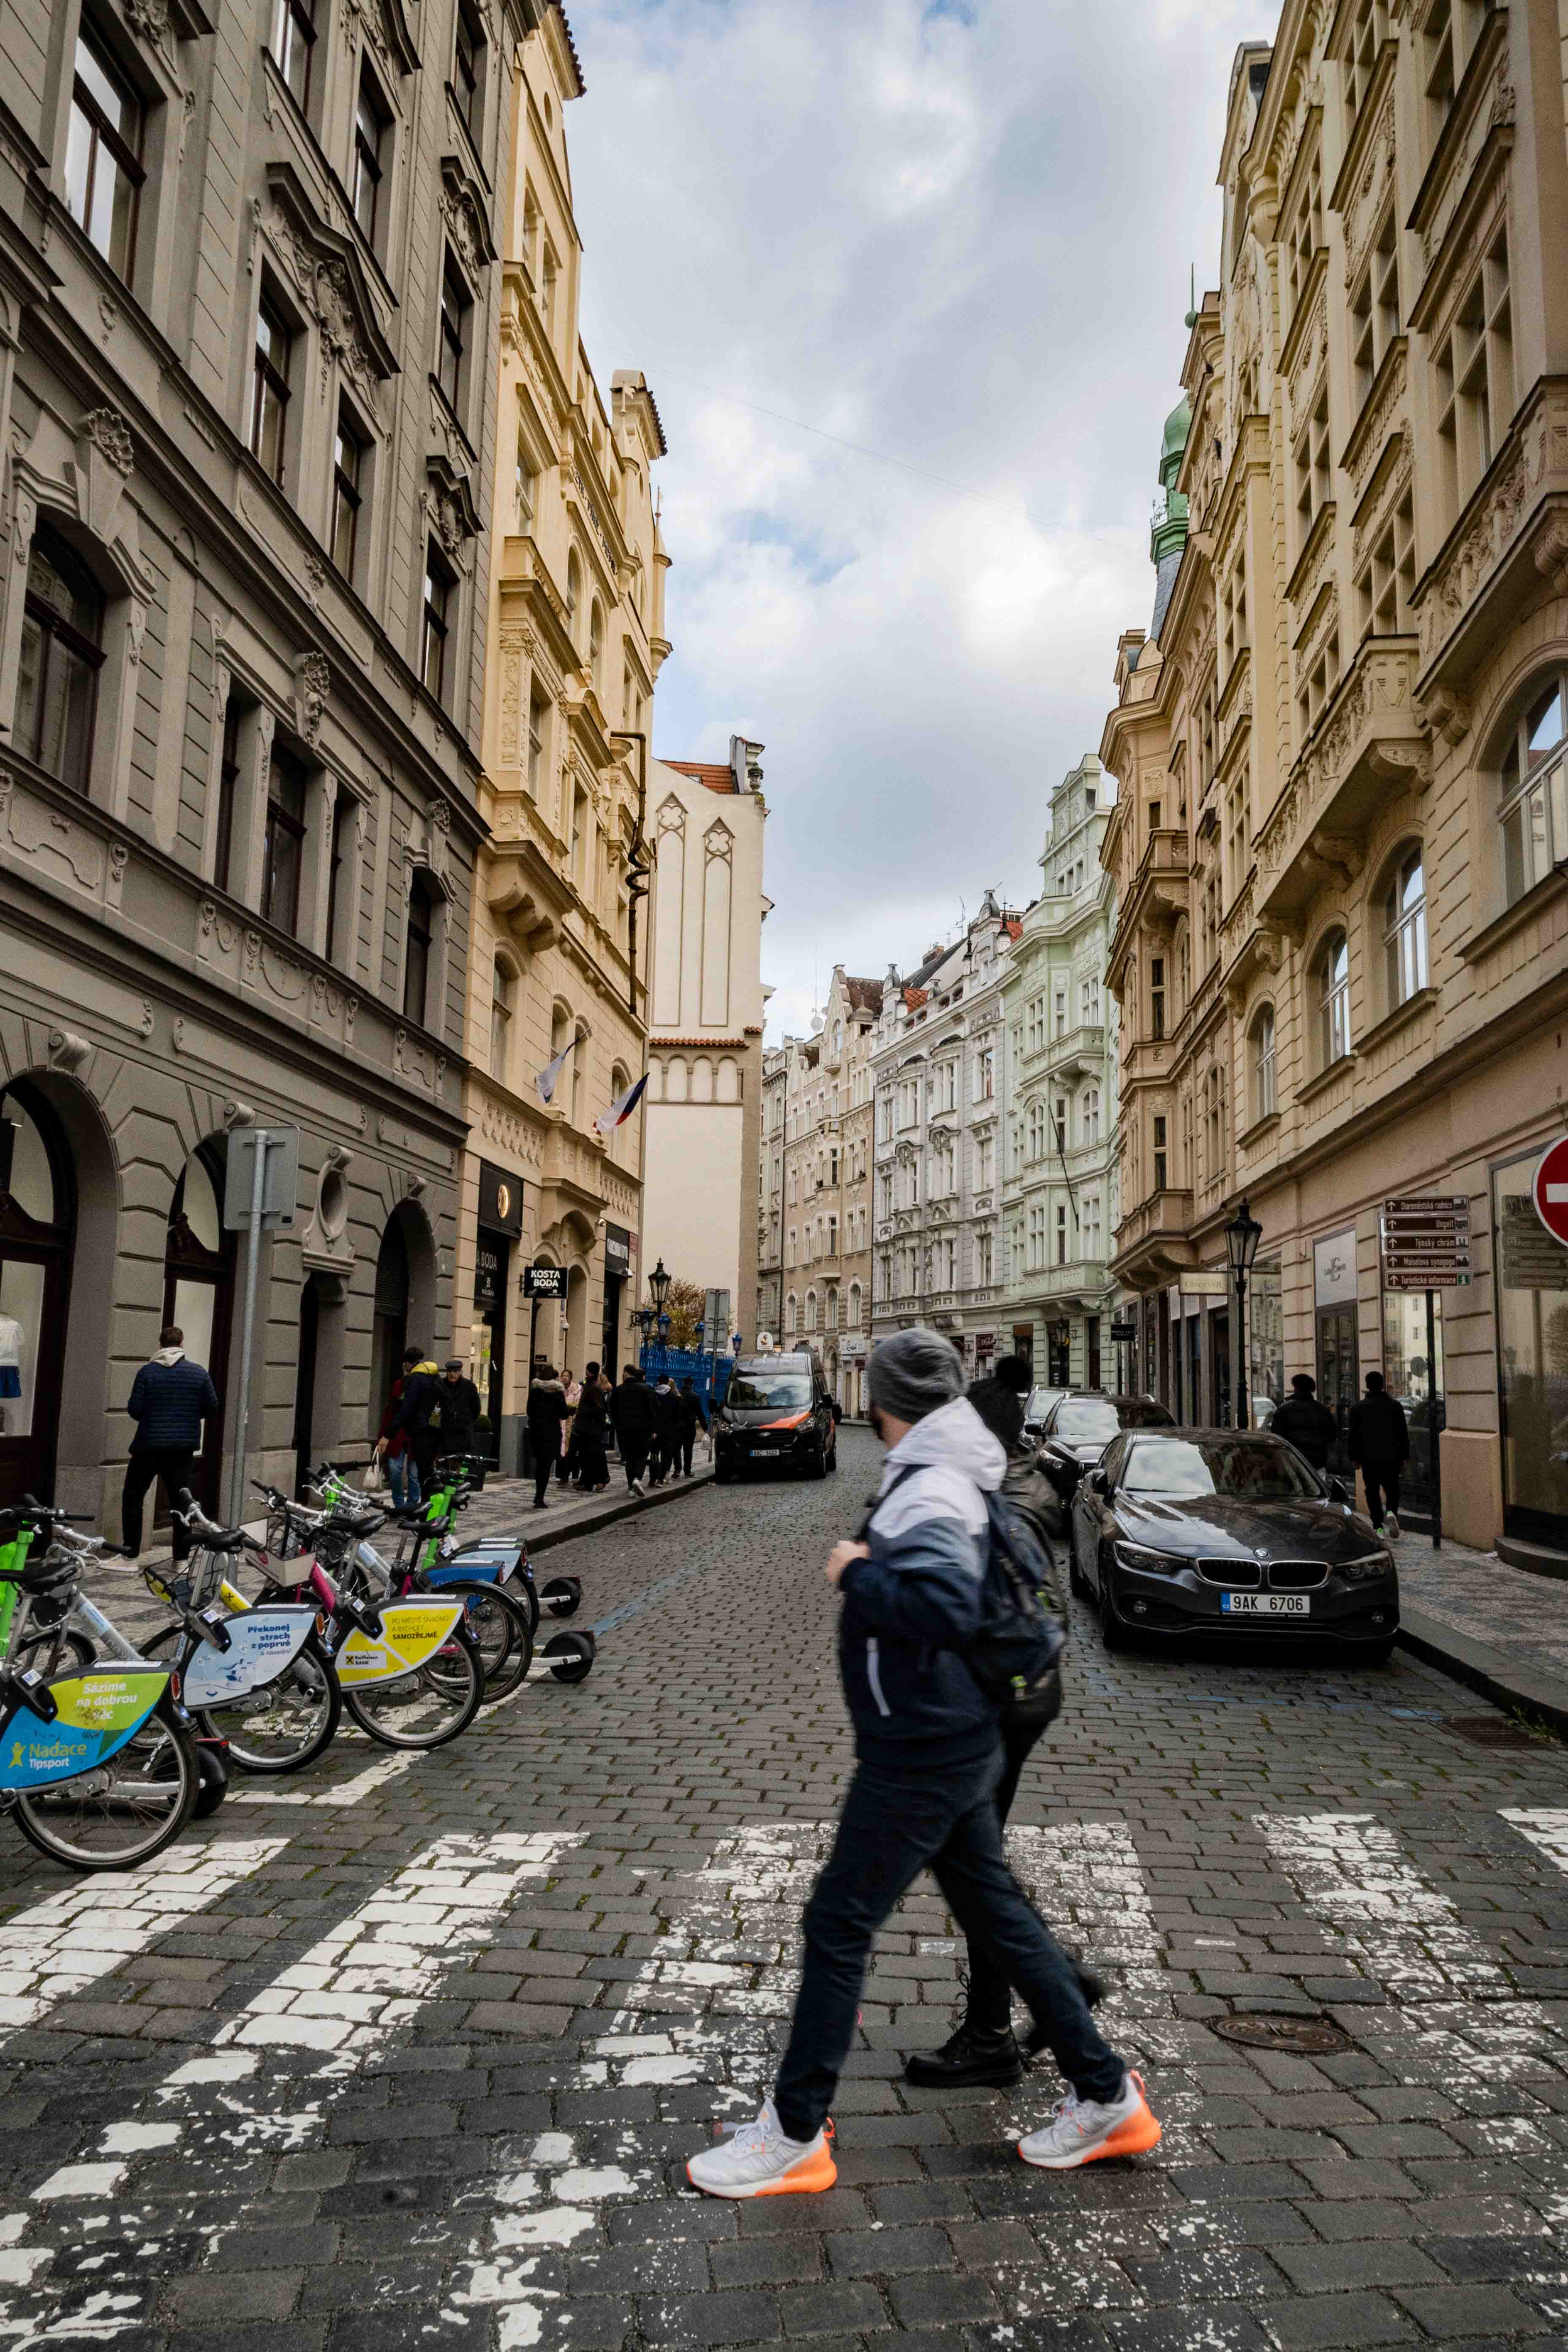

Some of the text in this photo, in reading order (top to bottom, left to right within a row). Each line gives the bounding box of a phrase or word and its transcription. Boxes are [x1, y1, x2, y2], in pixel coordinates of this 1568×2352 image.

[1436, 1220, 1454, 1230] Ungelt
[1415, 1238, 1455, 1248] Týnský chrám
[481, 1251, 497, 1271] BODA
[531, 1270, 561, 1278] KOSTA
[534, 1279, 559, 1287] BODA
[1401, 1276, 1427, 1284] Turistické
[1233, 1596, 1259, 1610] 9AK
[1269, 1597, 1303, 1611] 6706
[248, 1623, 290, 1633] Překonej
[392, 1631, 439, 1640] SAMOZŘEJMĚ.
[258, 1640, 291, 1650] poprvé
[84, 1682, 126, 1694] Sázíme
[76, 1694, 138, 1707] na dobrou
[29, 1742, 87, 1758] Nadace
[29, 1757, 70, 1770] Tipsport
